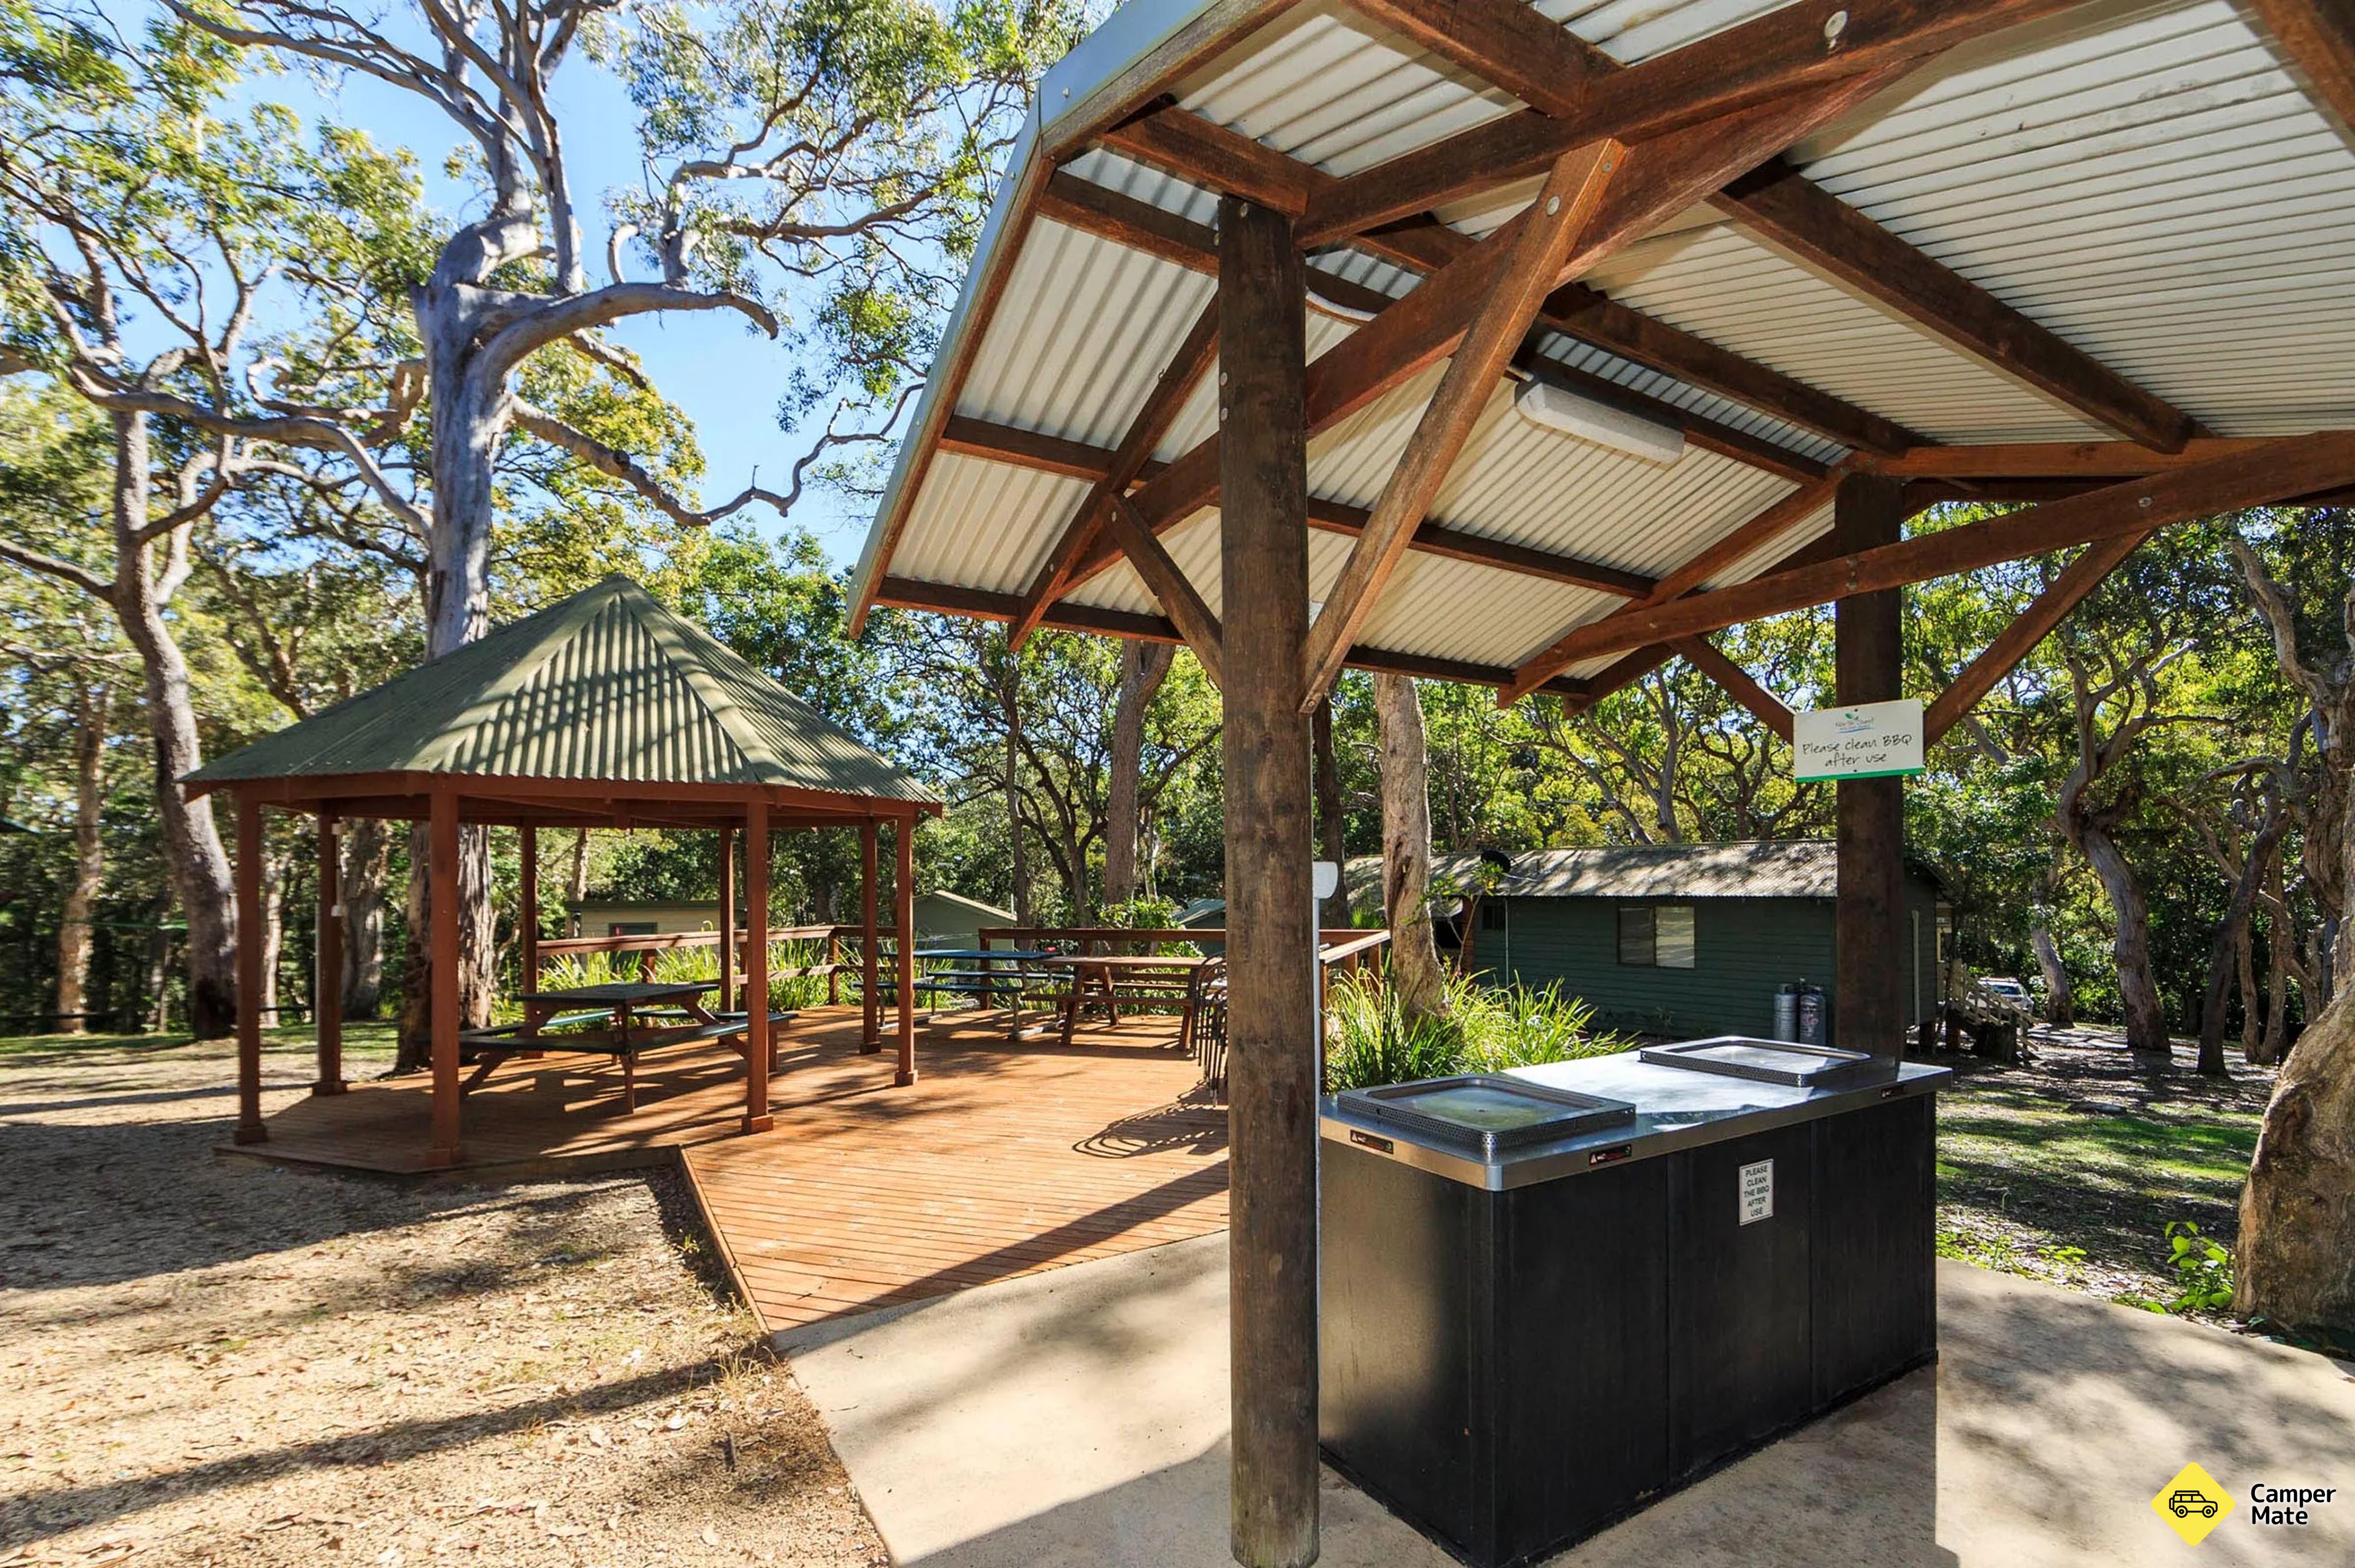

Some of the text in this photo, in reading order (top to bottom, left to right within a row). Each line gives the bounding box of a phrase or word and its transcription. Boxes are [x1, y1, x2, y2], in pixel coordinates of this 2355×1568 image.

[1802, 733, 1913, 755] Please clean BBQ
[1825, 752, 1888, 767] after use
[1746, 1165, 1767, 1177] PLEASE
[1747, 1176, 1767, 1186] CLEAN
[1743, 1185, 1769, 1198] THE BBQ
[1747, 1196, 1766, 1207] AFTER
[1750, 1207, 1763, 1217] USE
